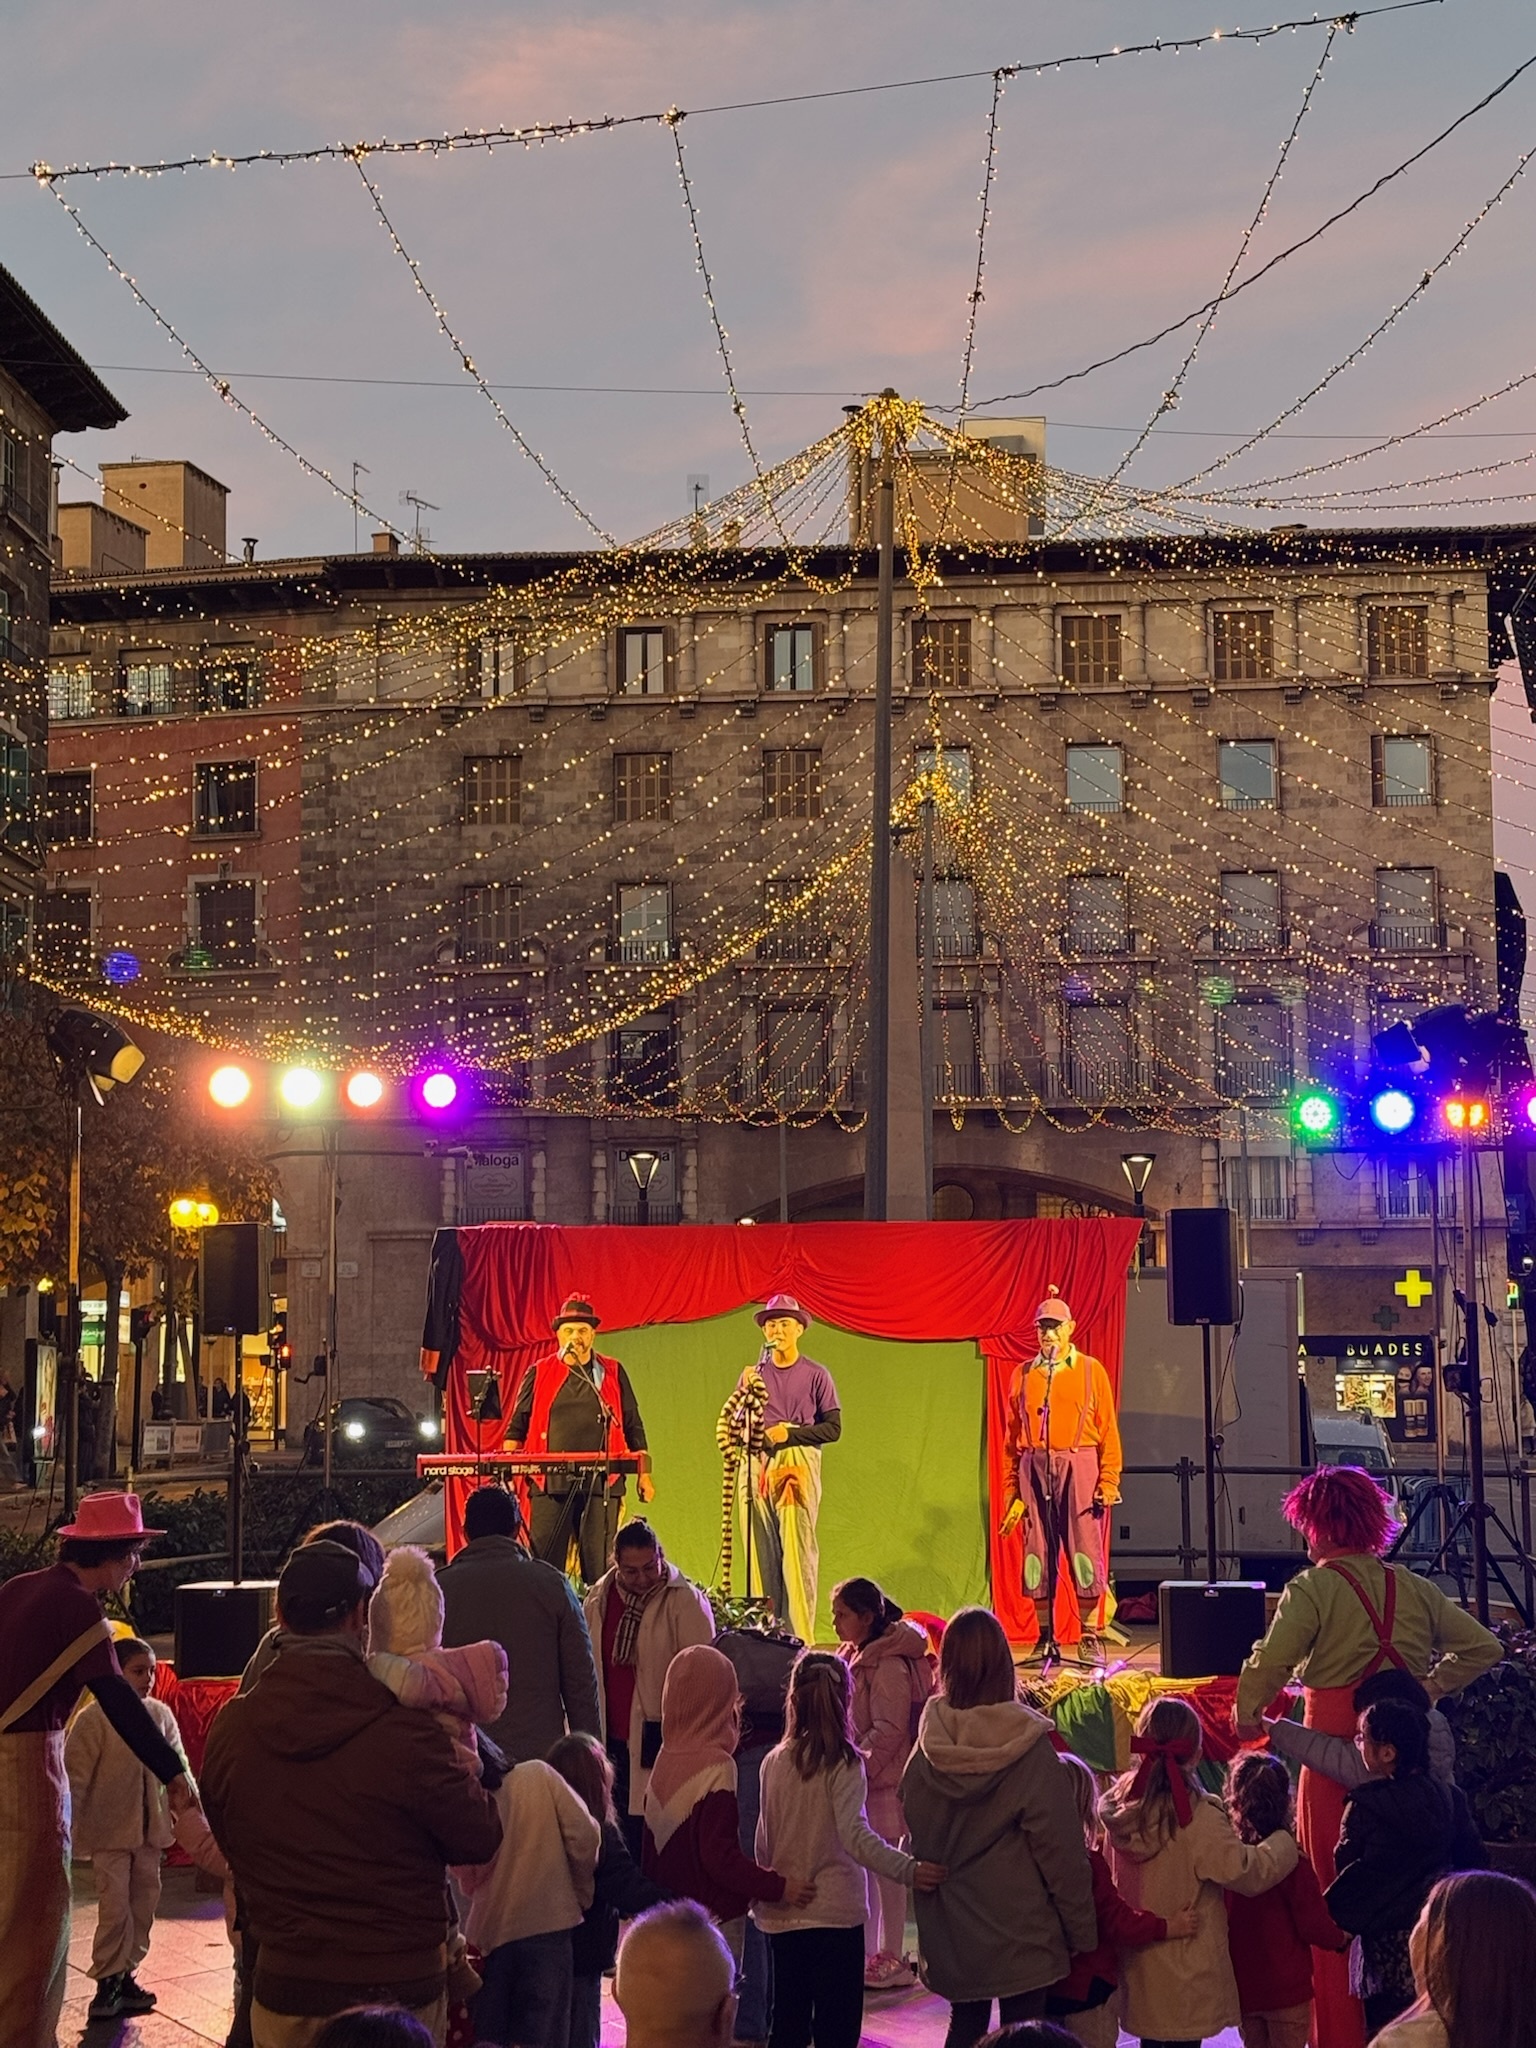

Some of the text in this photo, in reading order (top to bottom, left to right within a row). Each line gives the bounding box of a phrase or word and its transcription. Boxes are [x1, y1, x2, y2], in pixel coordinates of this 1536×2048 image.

[1346, 1342, 1423, 1356] BUADES
[423, 1465, 447, 1476] nord
[447, 1465, 475, 1477] stage
